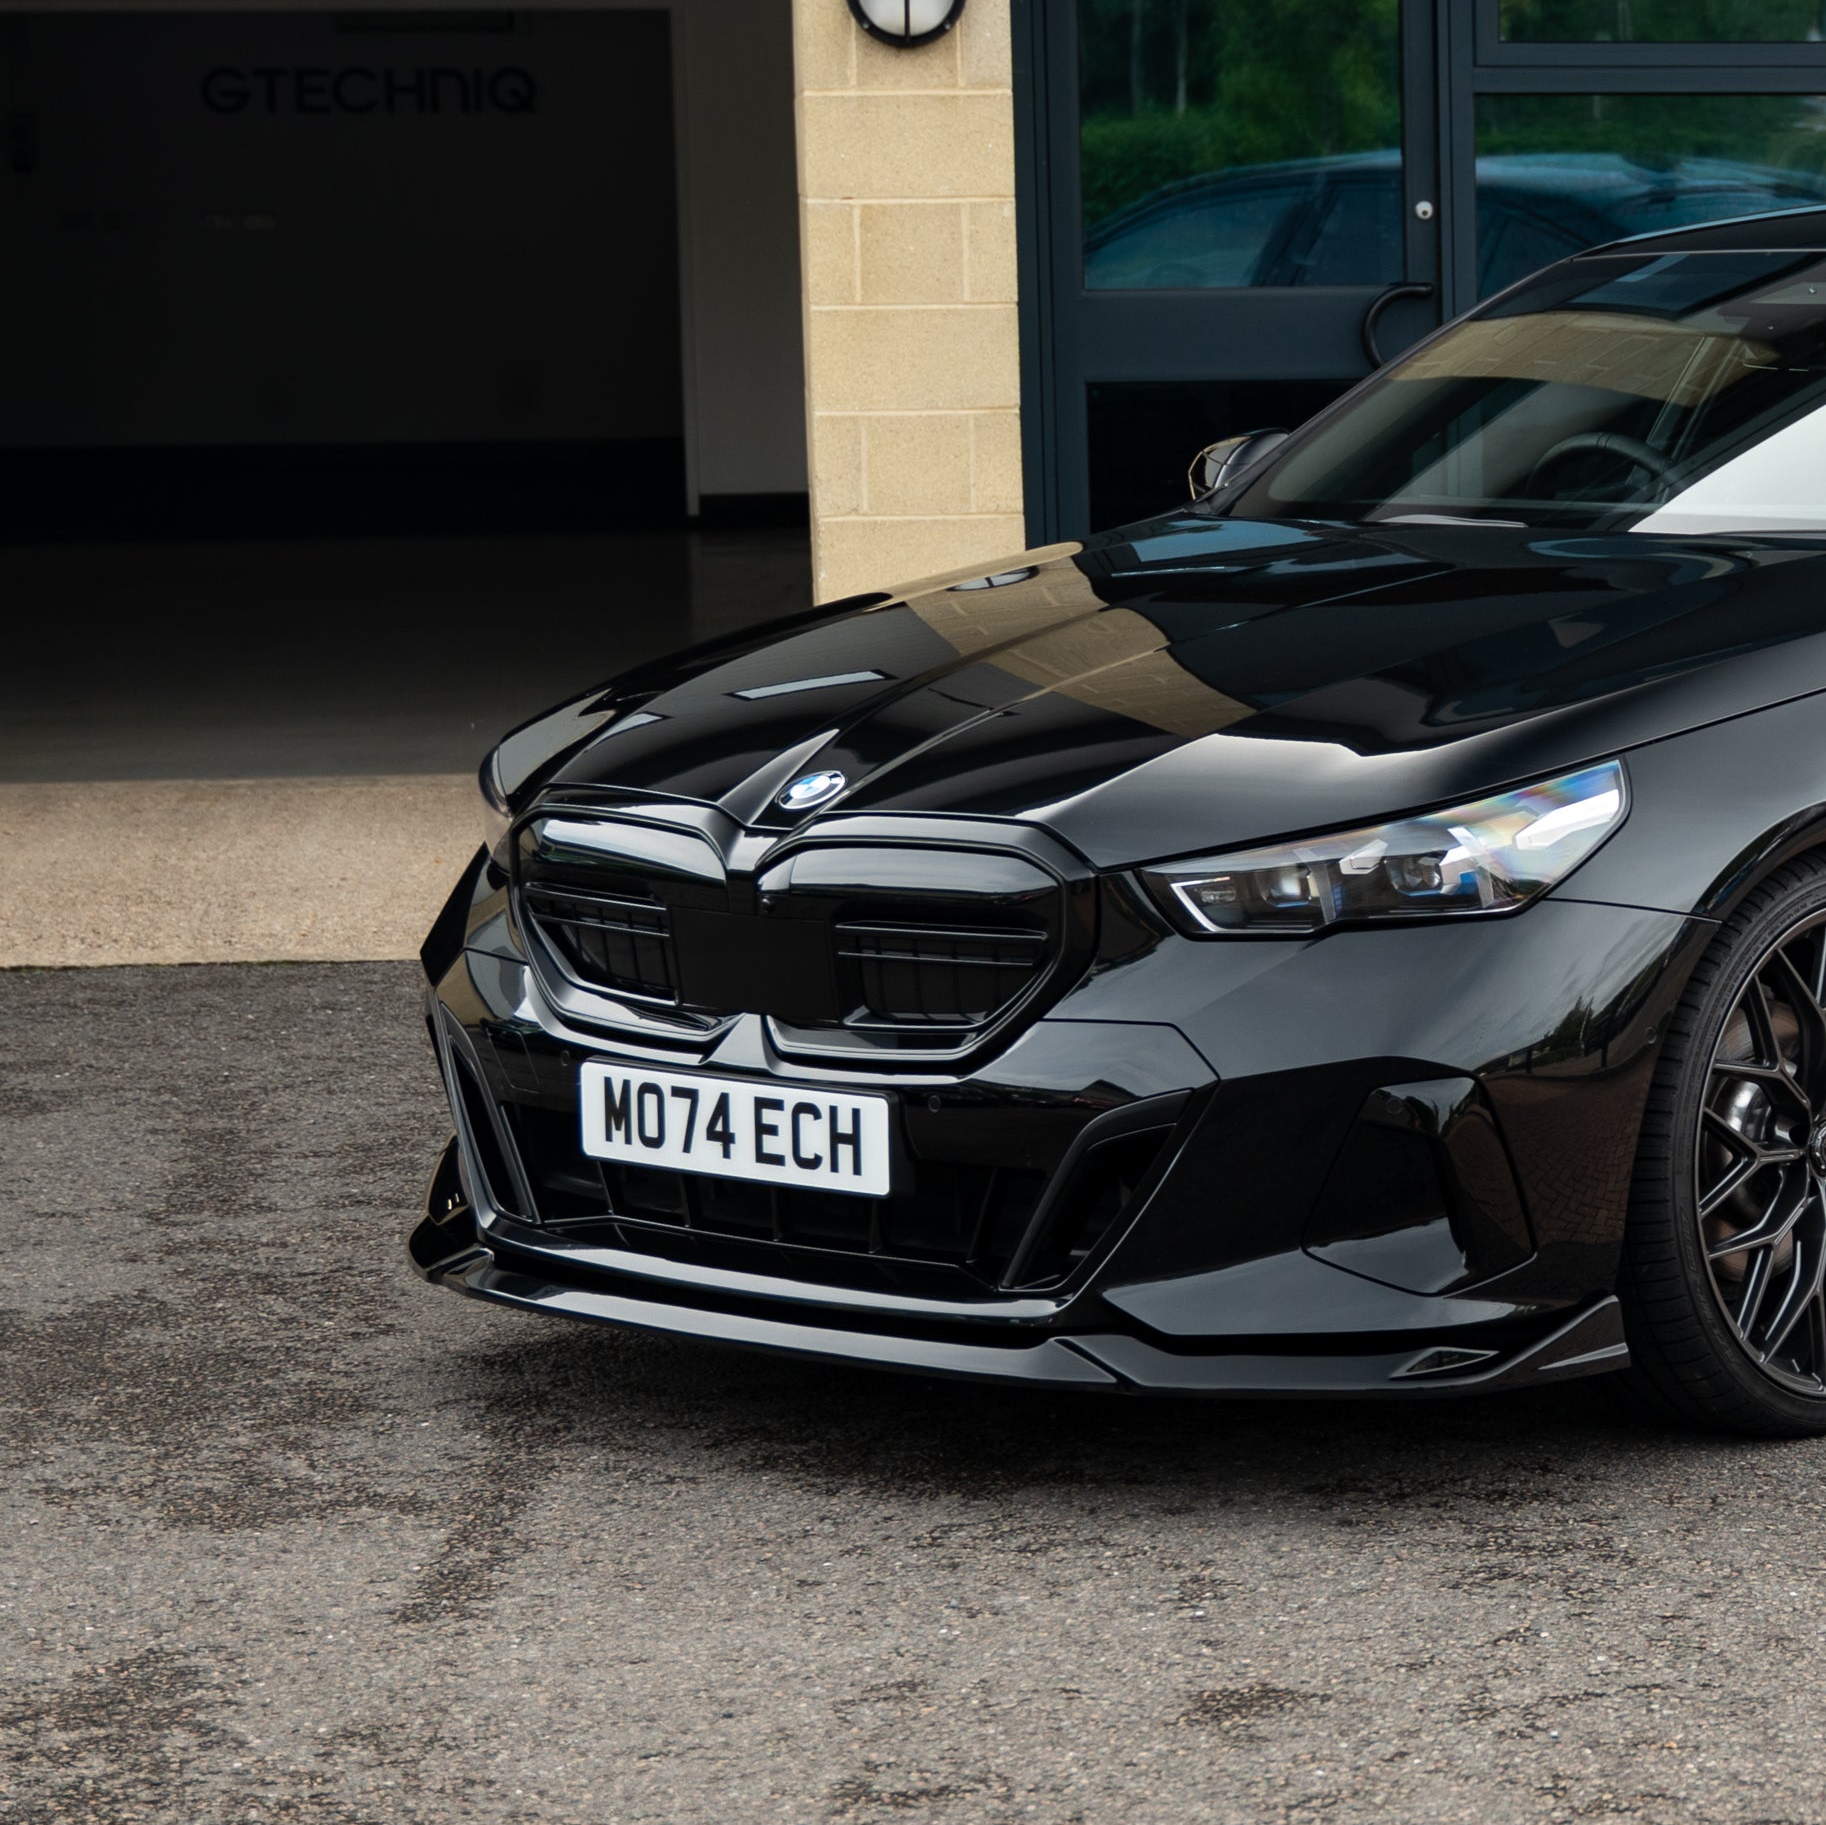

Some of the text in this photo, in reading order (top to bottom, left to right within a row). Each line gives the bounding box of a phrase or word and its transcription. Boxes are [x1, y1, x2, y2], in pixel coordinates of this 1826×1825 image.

[200, 65, 538, 115] GTECHNIQ
[603, 1075, 863, 1177] MO74 ECH
